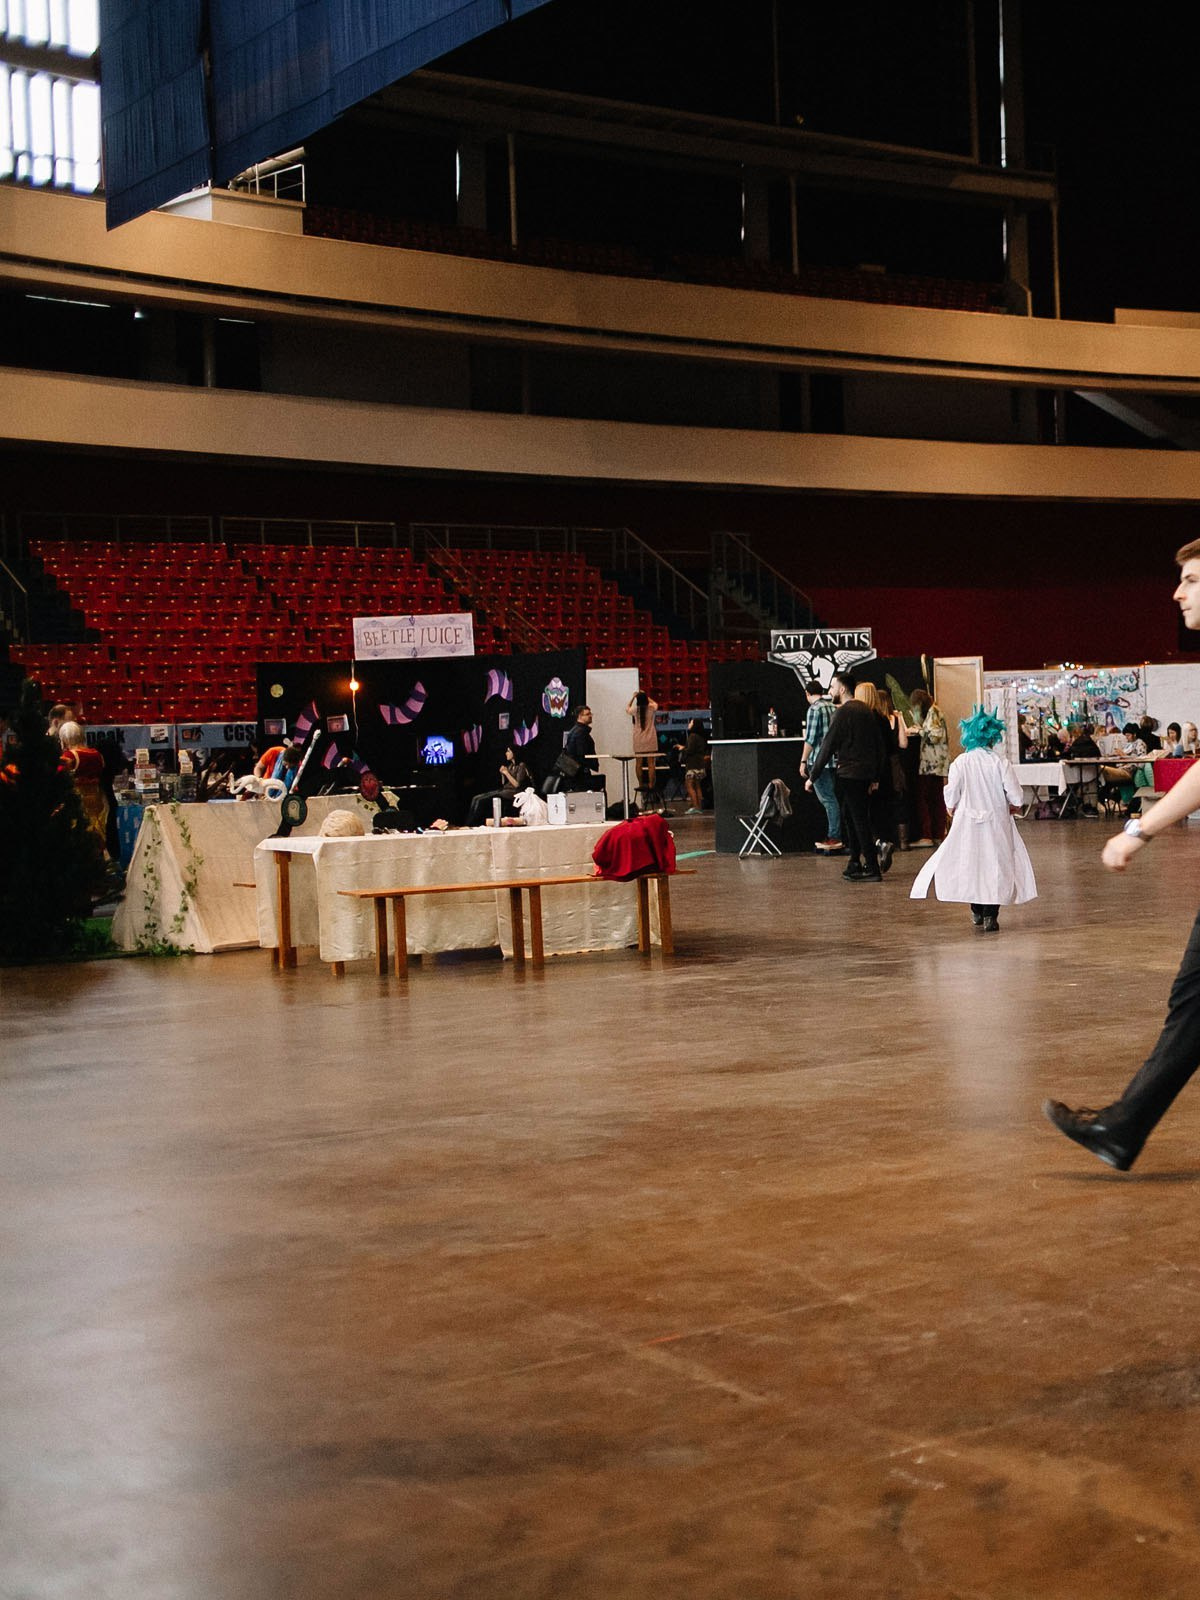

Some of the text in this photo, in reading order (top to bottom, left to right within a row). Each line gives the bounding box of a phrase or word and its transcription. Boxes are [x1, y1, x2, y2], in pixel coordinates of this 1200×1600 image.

[363, 626, 463, 647] BEETLE JUICE
[775, 632, 871, 650] ATLANTIS
